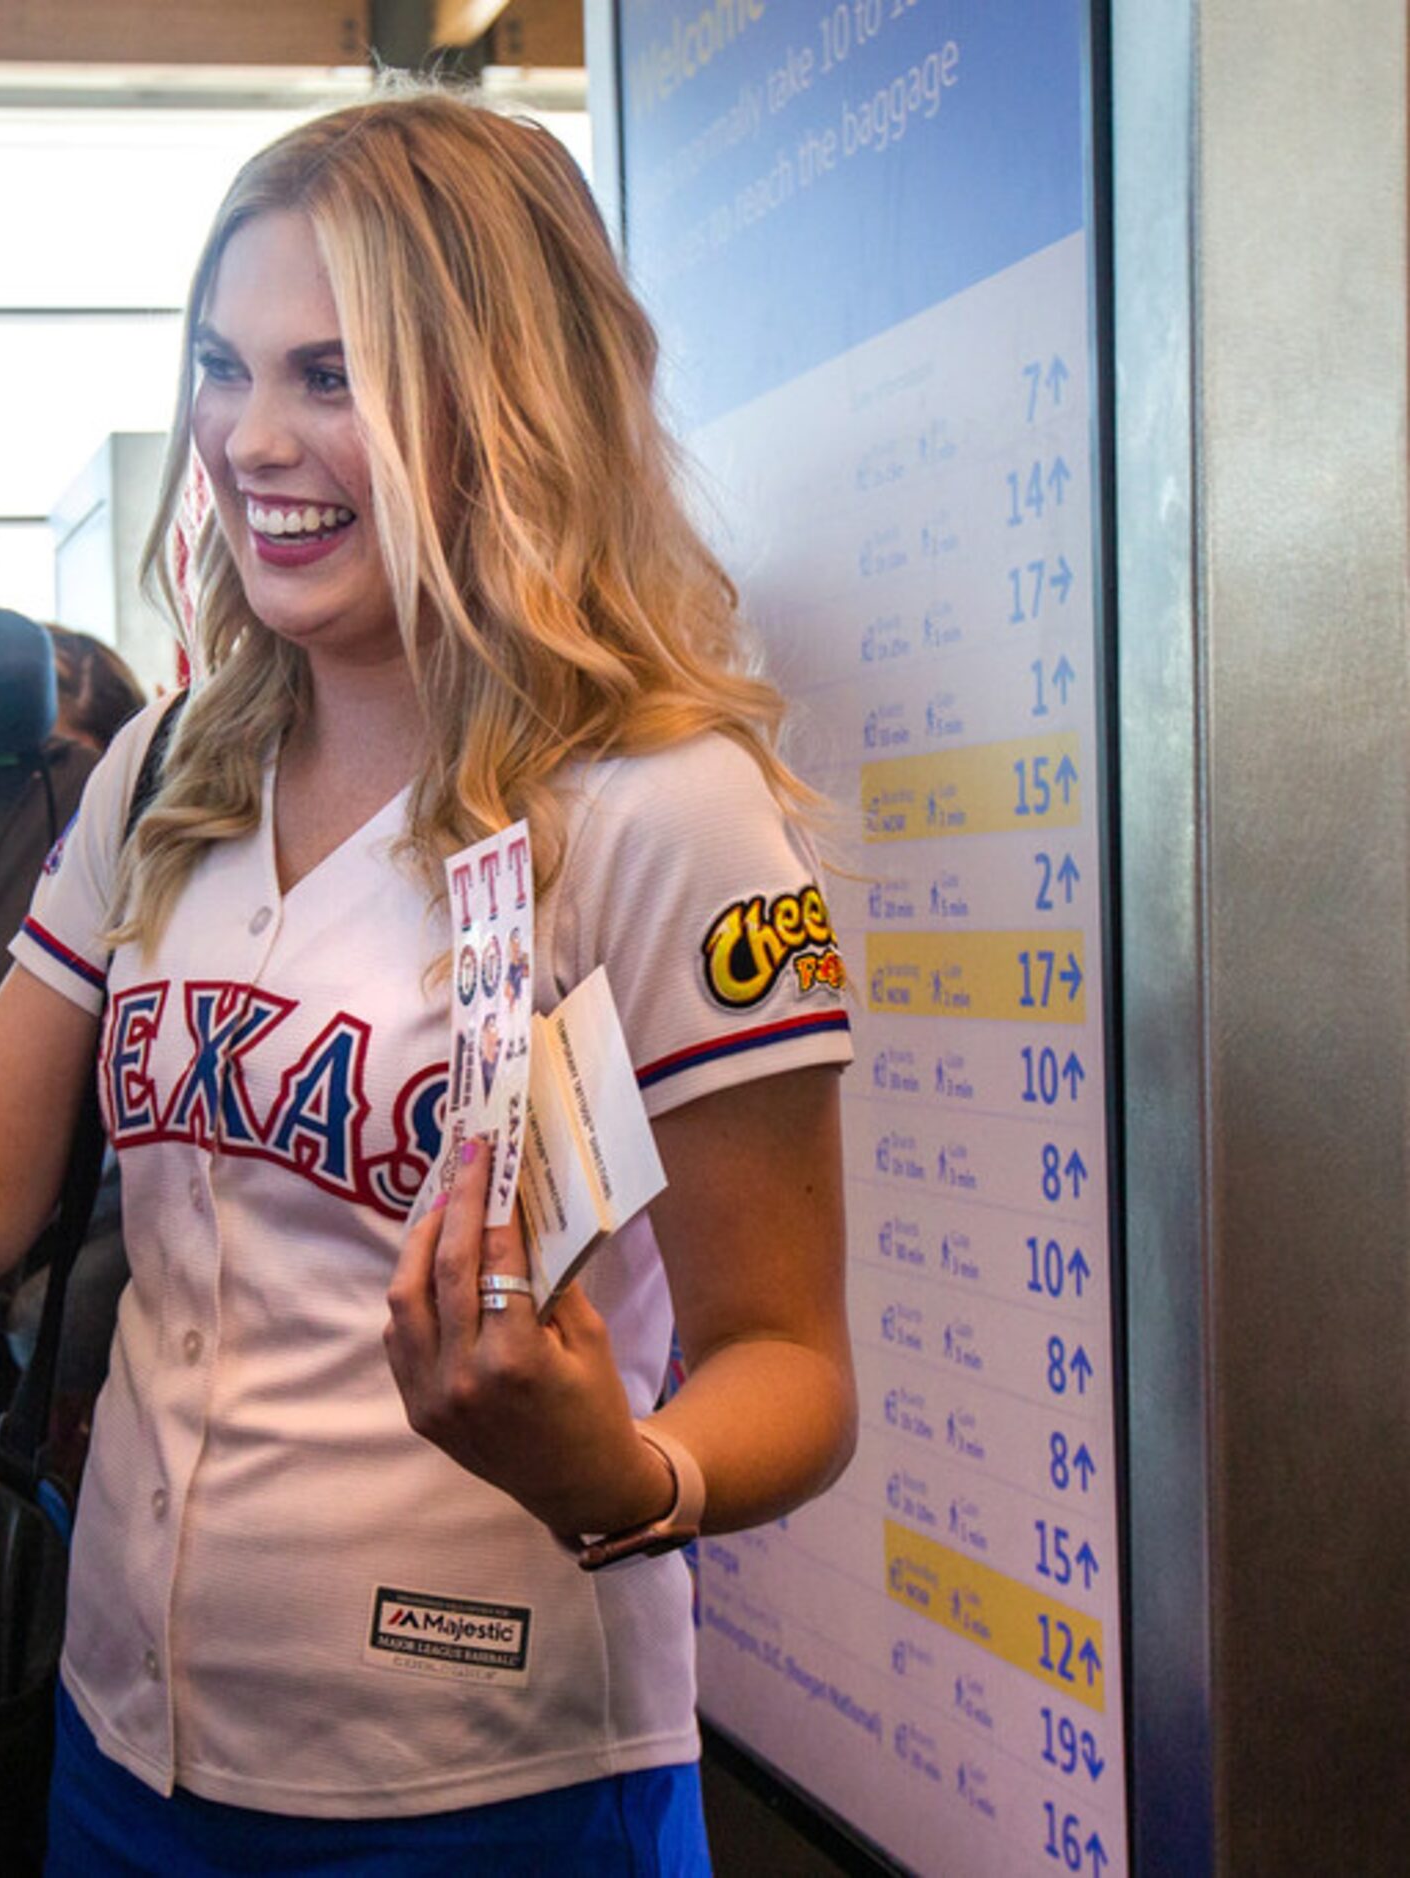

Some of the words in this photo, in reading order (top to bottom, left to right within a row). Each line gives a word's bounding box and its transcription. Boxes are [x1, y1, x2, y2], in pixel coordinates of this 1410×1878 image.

[766, 46, 814, 115] take
[821, 3, 850, 75] 10
[798, 127, 837, 188] the
[842, 40, 960, 157] baggage
[1023, 361, 1041, 423] 7
[1006, 459, 1045, 528] 14
[1008, 558, 1046, 625] 17
[1030, 658, 1049, 717] 1
[1013, 755, 1052, 817] 15
[453, 864, 472, 932] T
[480, 851, 500, 921] T
[508, 837, 528, 910] T
[1035, 852, 1054, 911] 2
[701, 884, 839, 1008] Chee
[1017, 950, 1056, 1009] 17
[100, 979, 452, 1222] EXAS
[1020, 1045, 1059, 1106] 10
[1042, 1142, 1062, 1201] 8
[1025, 1236, 1065, 1298] 10
[1047, 1334, 1068, 1395] 8
[1049, 1430, 1070, 1491] 8
[1034, 1519, 1073, 1586] 15
[422, 1612, 514, 1642] Majestic
[1037, 1613, 1076, 1683] 12
[1040, 1707, 1079, 1776] 19
[1043, 1801, 1084, 1873] 16
